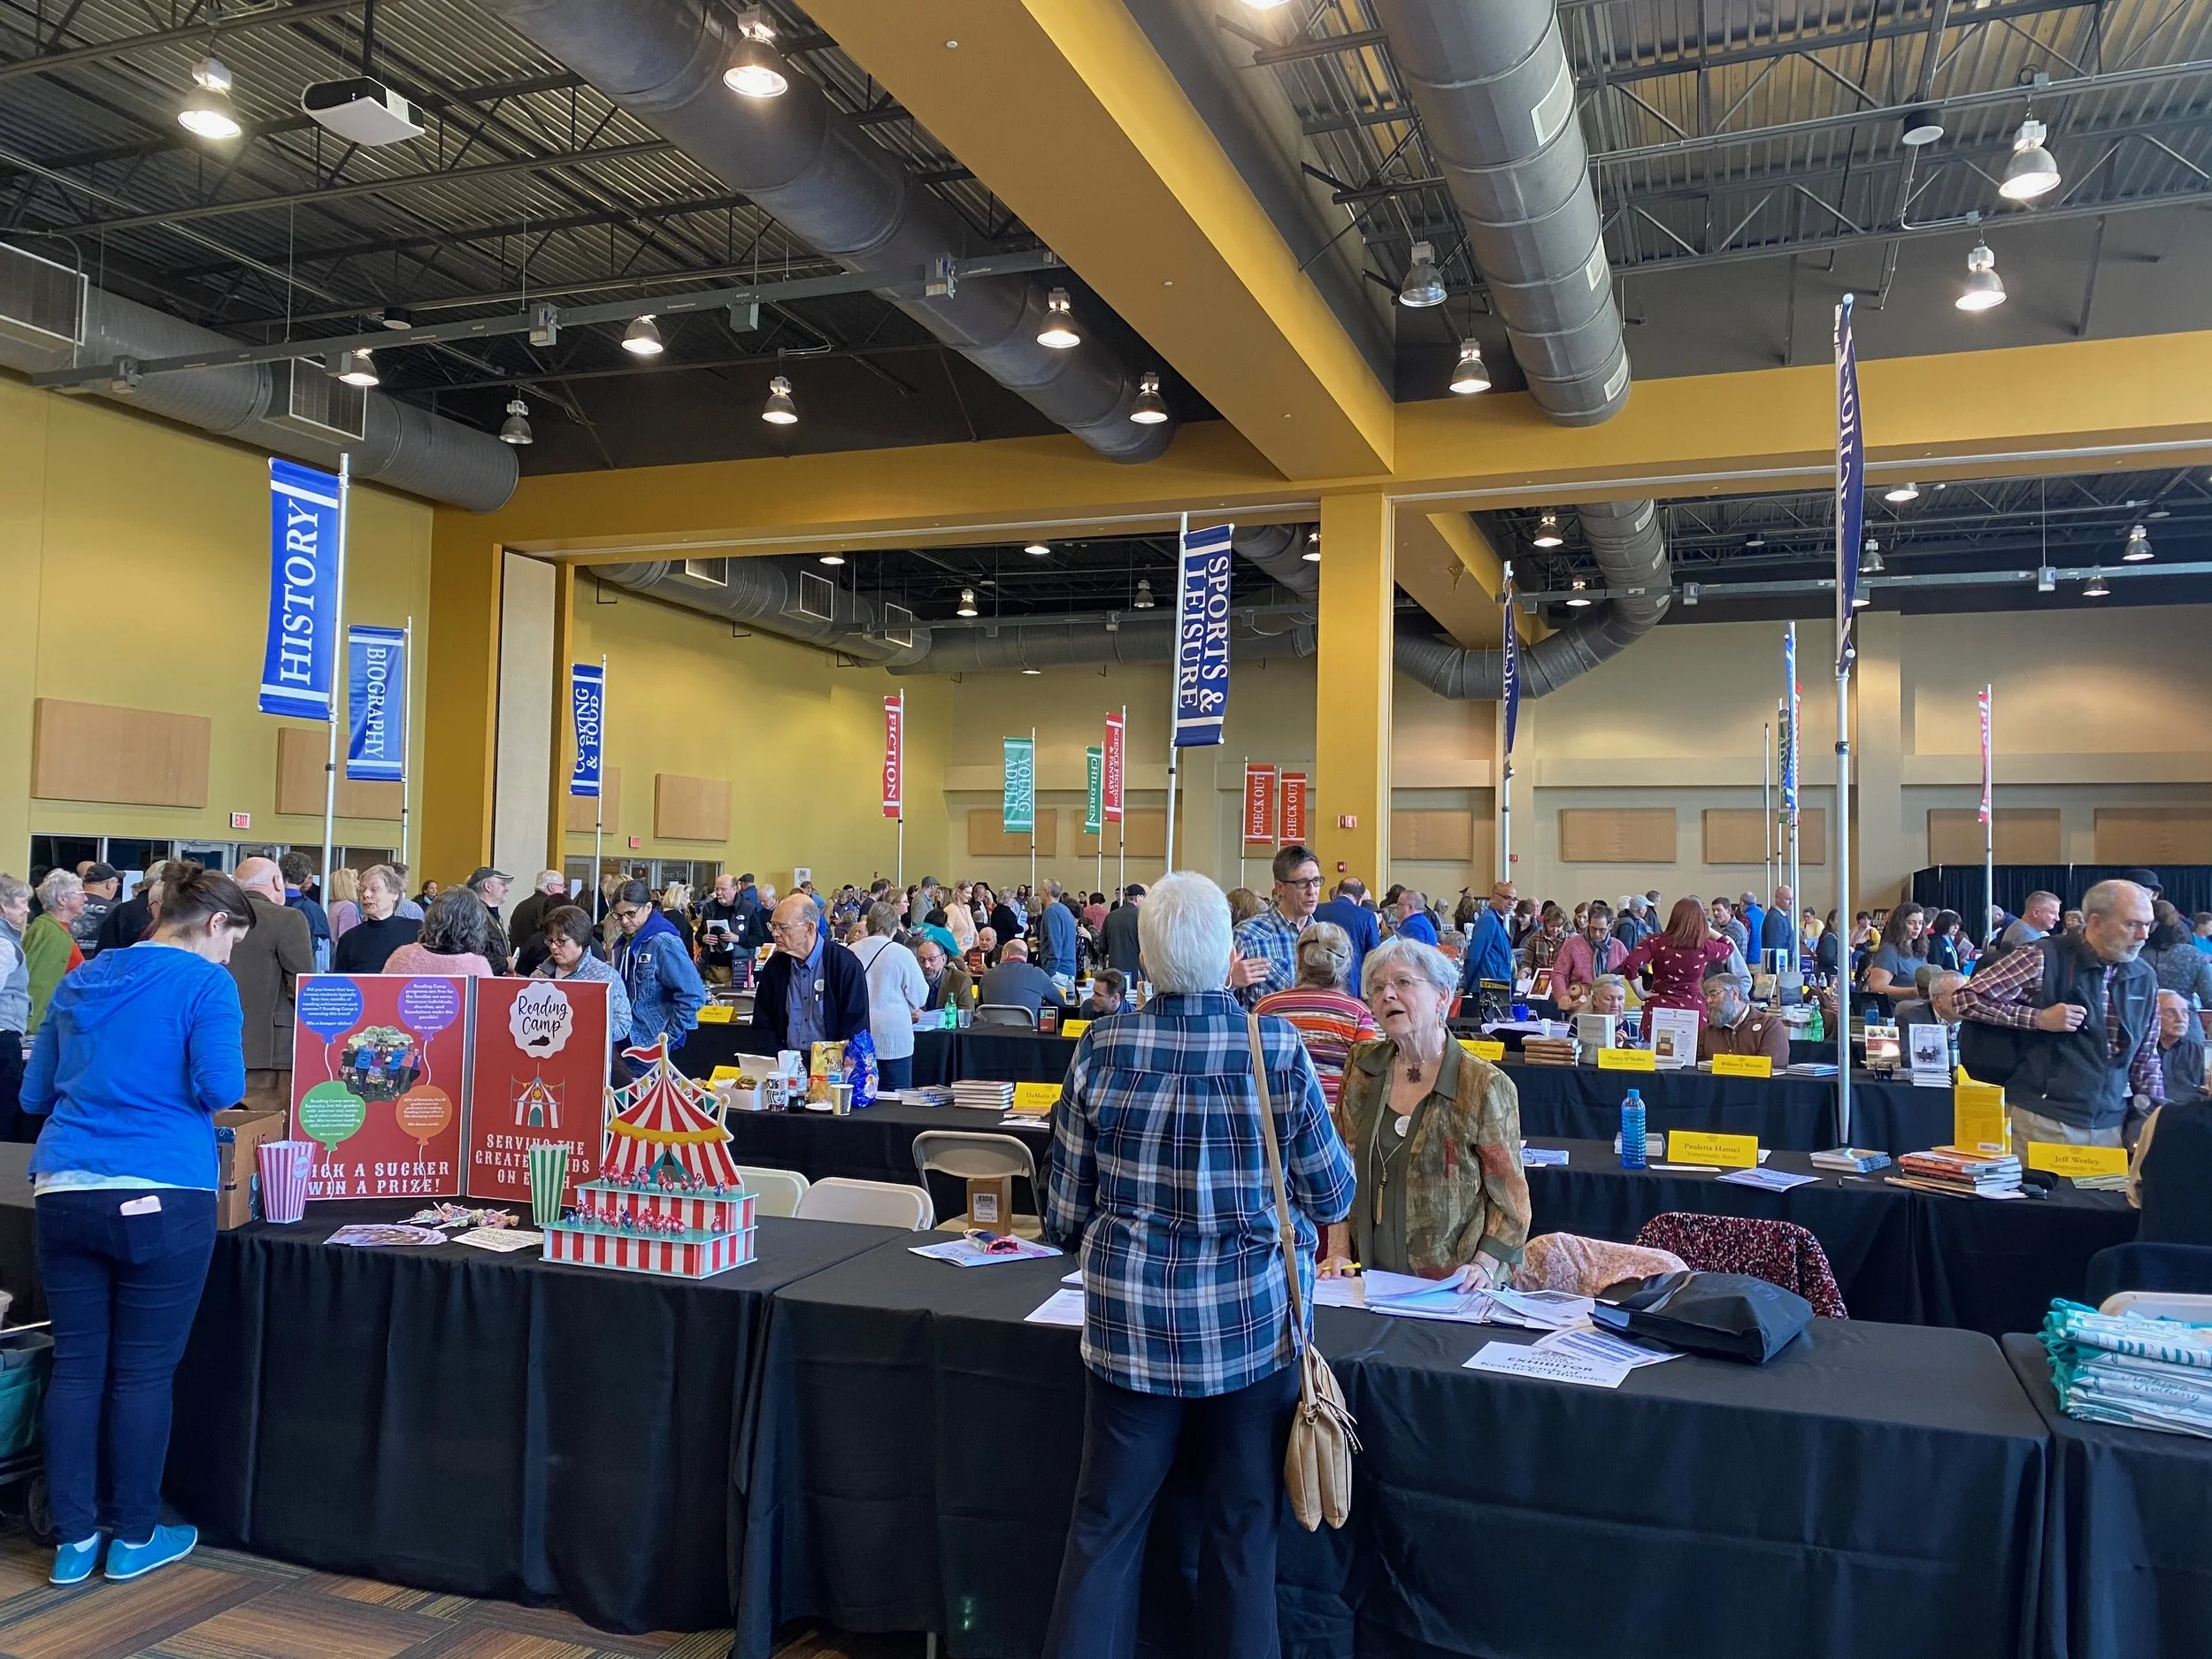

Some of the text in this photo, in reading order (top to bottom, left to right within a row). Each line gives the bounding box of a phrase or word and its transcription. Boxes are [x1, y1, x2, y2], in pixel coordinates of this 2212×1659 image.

[280, 498, 319, 687] HISTORY
[1179, 566, 1207, 709] LEISURE
[1199, 556, 1229, 714] SPORTS &
[365, 646, 387, 760] BIOGRAPHY
[586, 755, 598, 770] &
[886, 713, 897, 800] FICTION
[1004, 758, 1018, 810] ADULT
[1018, 757, 1032, 813] YOUNG
[1088, 757, 1098, 823] CHILDREN
[1252, 775, 1266, 835] CHECK OUT
[1286, 782, 1298, 838] CHECK OUT
[518, 995, 568, 1021] Reading
[522, 1017, 562, 1039] Camp
[308, 1179, 441, 1195] WIN A PRIZE!
[311, 1163, 346, 1179] ICK
[354, 1163, 365, 1178] A
[374, 1161, 449, 1177] SUCKER
[475, 1150, 590, 1174] GREATE IDS
[497, 1169, 516, 1184] ON
[1507, 1357, 1594, 1372] EXHIBITOR
